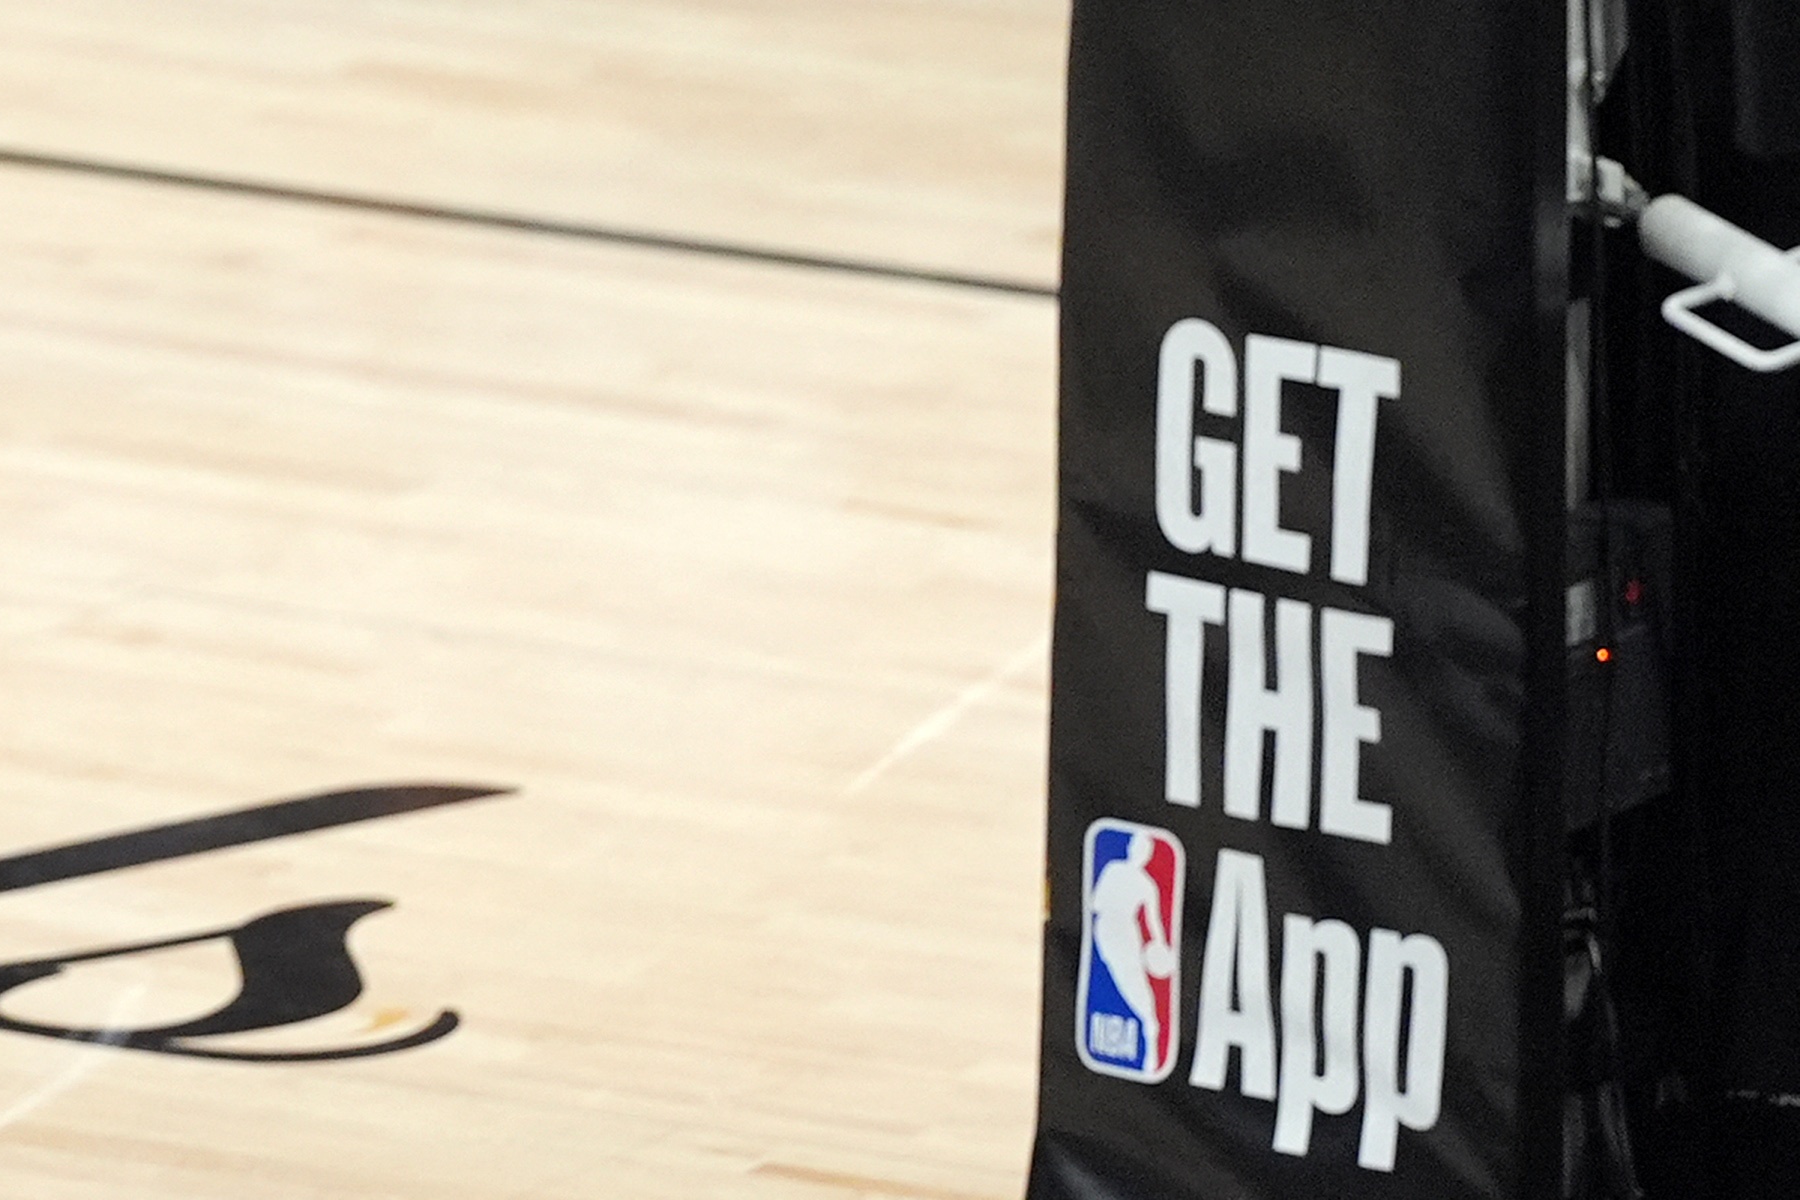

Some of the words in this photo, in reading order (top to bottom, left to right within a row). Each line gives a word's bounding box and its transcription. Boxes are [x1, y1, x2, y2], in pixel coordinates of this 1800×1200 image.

[1155, 317, 1401, 587] GET
[1145, 570, 1395, 845] THE
[1089, 1010, 1140, 1061] NBA
[1189, 848, 1450, 1173] App
